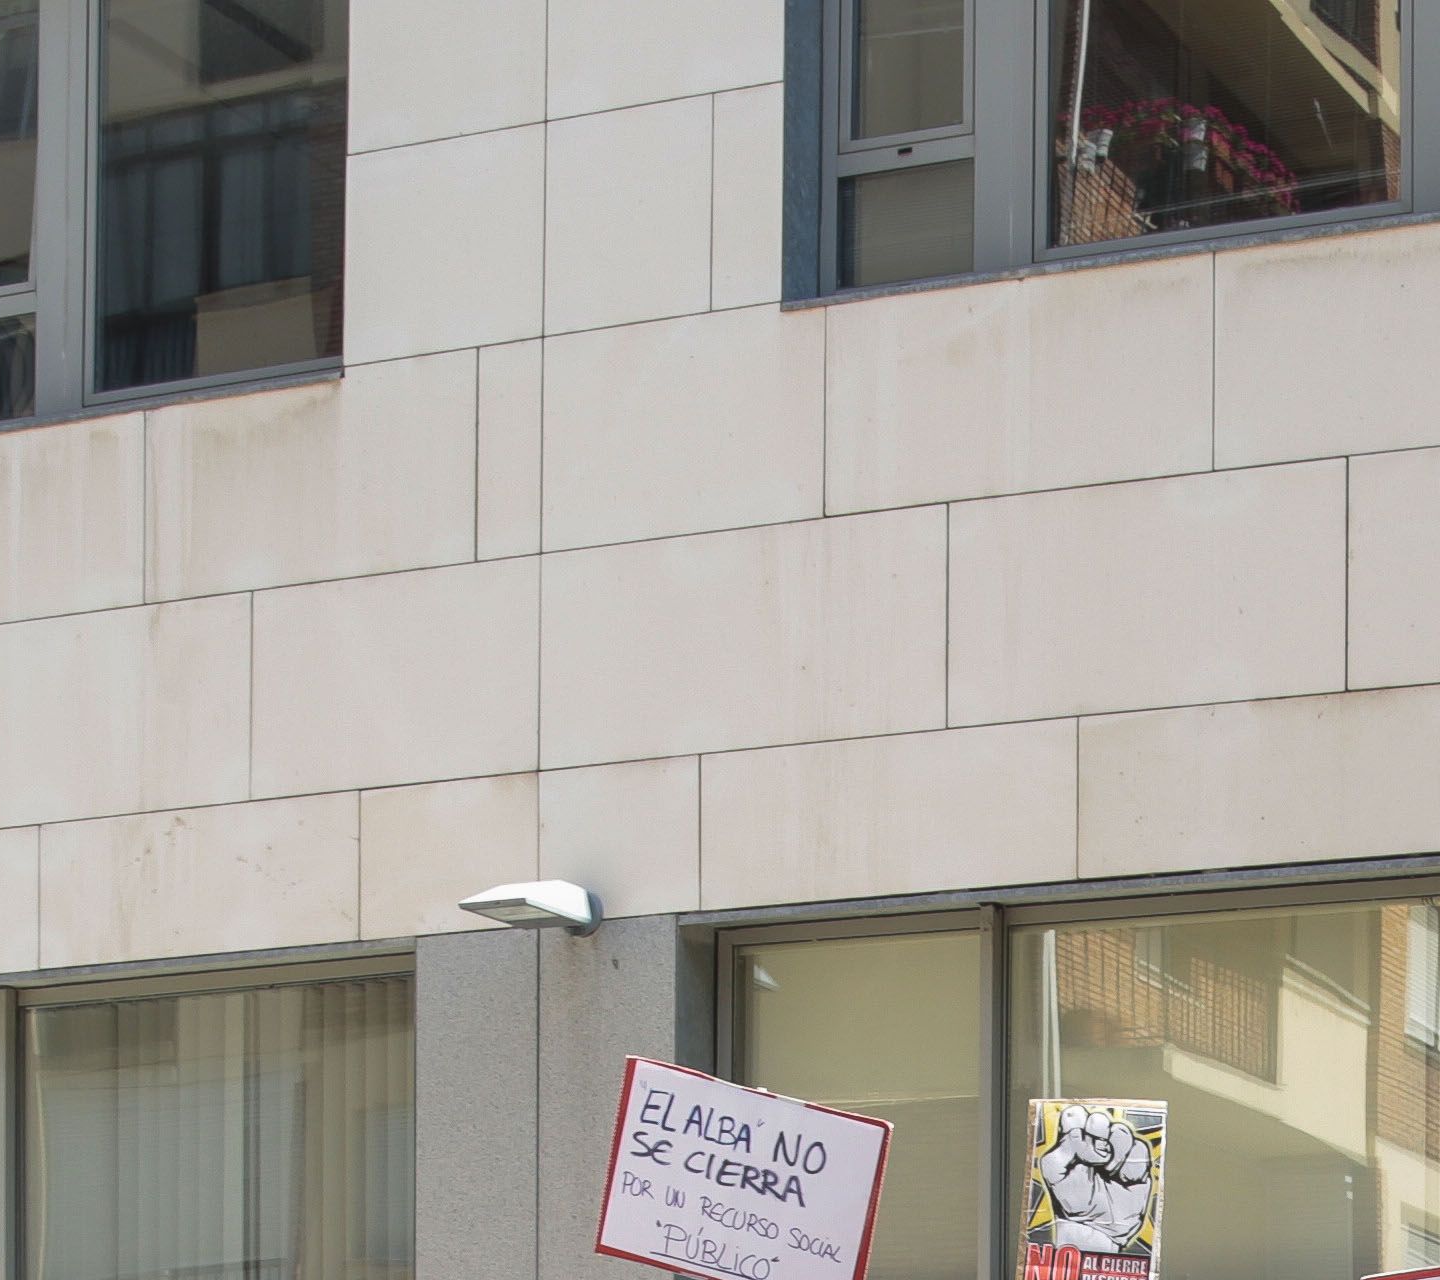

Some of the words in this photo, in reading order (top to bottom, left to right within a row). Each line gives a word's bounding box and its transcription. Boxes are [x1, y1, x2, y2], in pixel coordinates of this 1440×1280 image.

[630, 1131, 673, 1165] SE
[684, 1151, 806, 1208] CIERRA
[773, 1130, 826, 1174] NO
[623, 1171, 654, 1200] POR
[666, 1186, 686, 1209] UN
[700, 1196, 779, 1239] RECURSO
[787, 1228, 841, 1263] SOCIAL
[1083, 1257, 1097, 1271] AL
[1102, 1258, 1147, 1275] CIERRE
